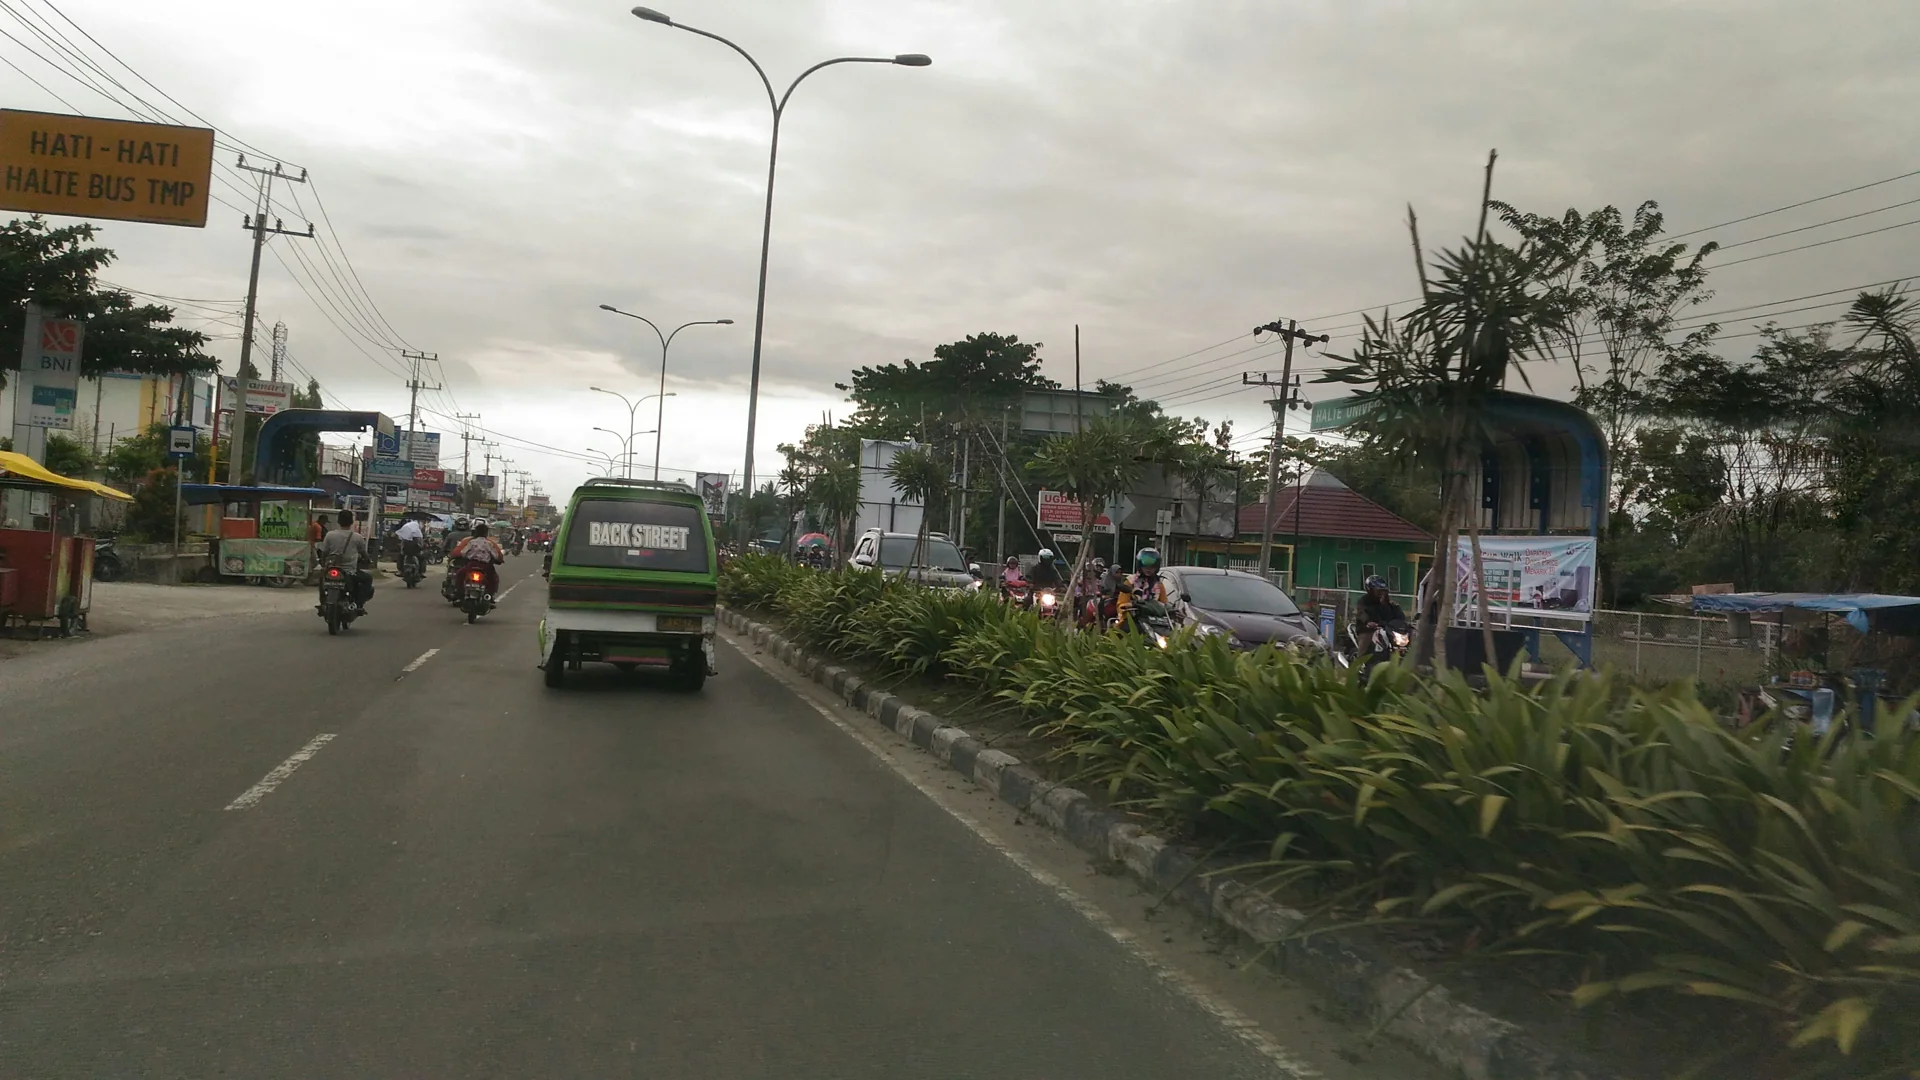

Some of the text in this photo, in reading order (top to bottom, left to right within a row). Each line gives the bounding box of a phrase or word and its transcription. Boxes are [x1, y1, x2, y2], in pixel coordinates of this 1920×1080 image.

[30, 131, 92, 159] HATI
[117, 139, 178, 167] HATI
[6, 165, 195, 207] HALTE BUS TMP
[41, 356, 72, 371] BNI
[1044, 495, 1068, 504] UGD
[589, 521, 690, 551] BACK STREET
